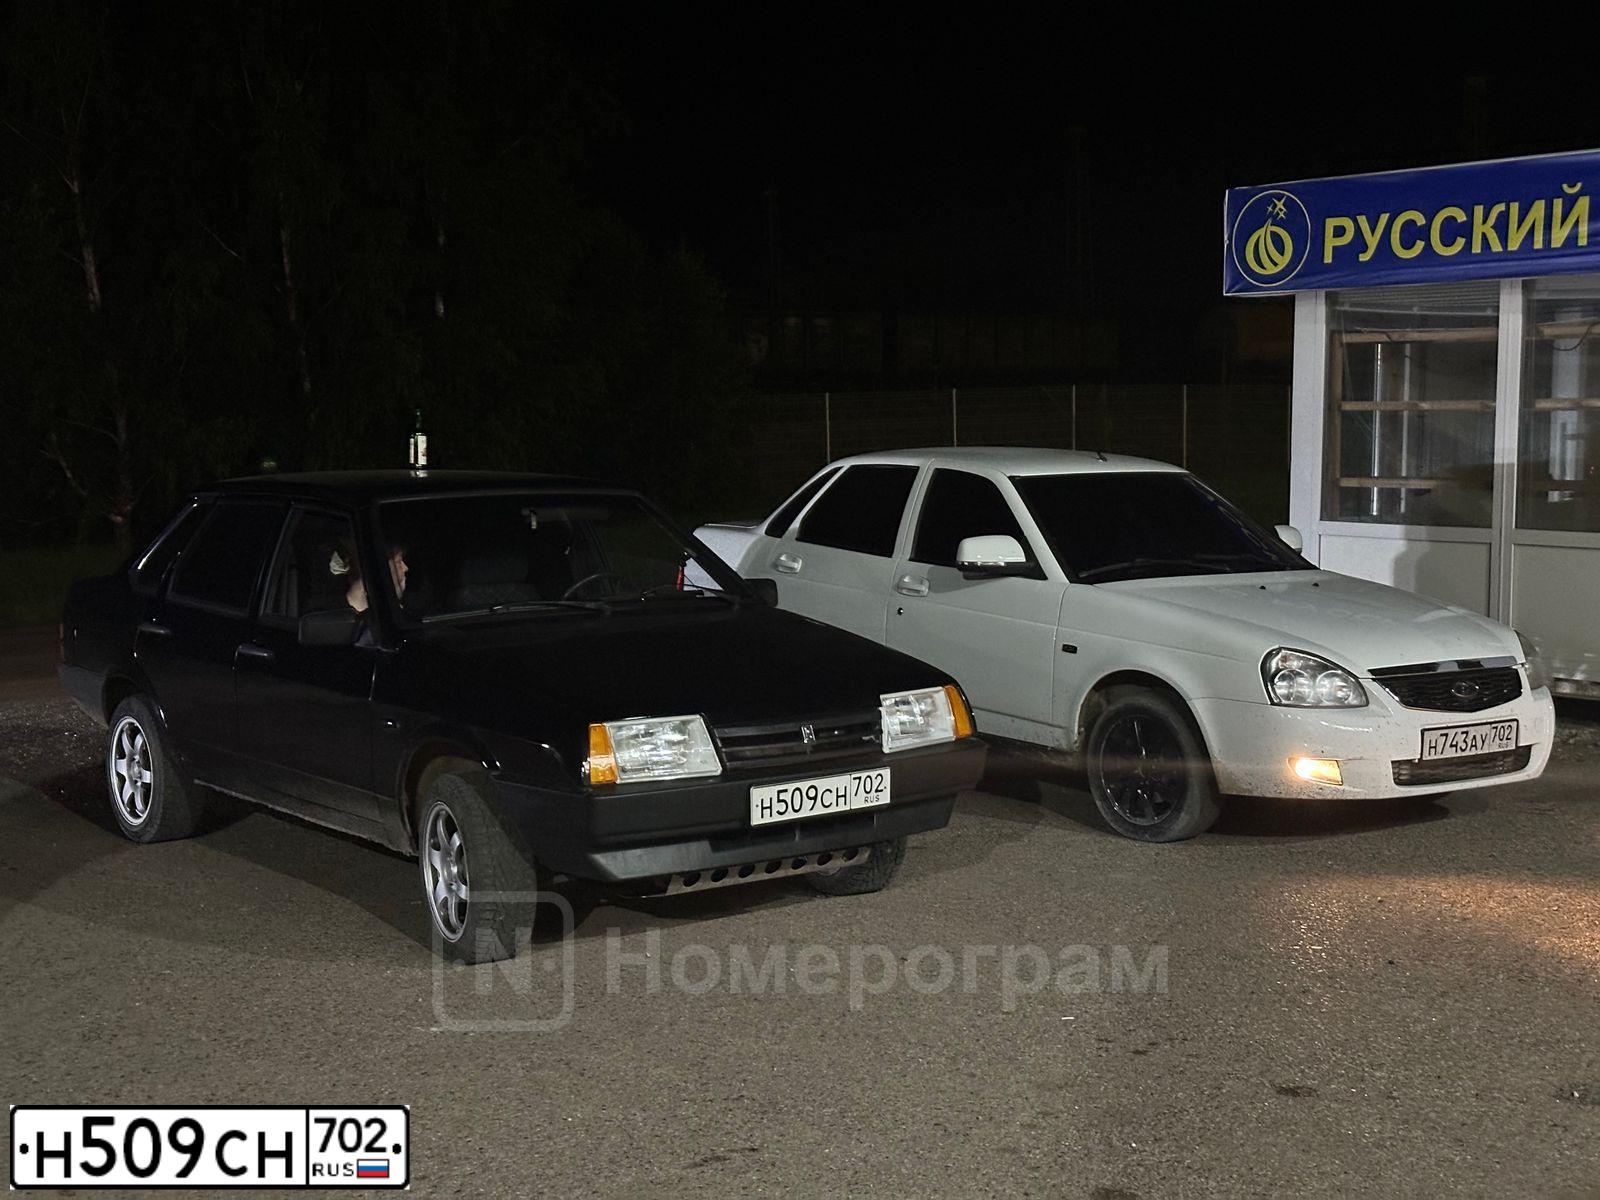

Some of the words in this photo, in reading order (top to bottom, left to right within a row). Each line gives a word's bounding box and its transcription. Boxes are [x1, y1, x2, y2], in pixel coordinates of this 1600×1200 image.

[1323, 182, 1590, 264] РУССКИЙ
[1428, 731, 1488, 756] Н743АУ
[1492, 725, 1513, 742] 702
[760, 785, 847, 819] Н509СН
[853, 773, 884, 797] 702
[864, 795, 880, 804] RUS
